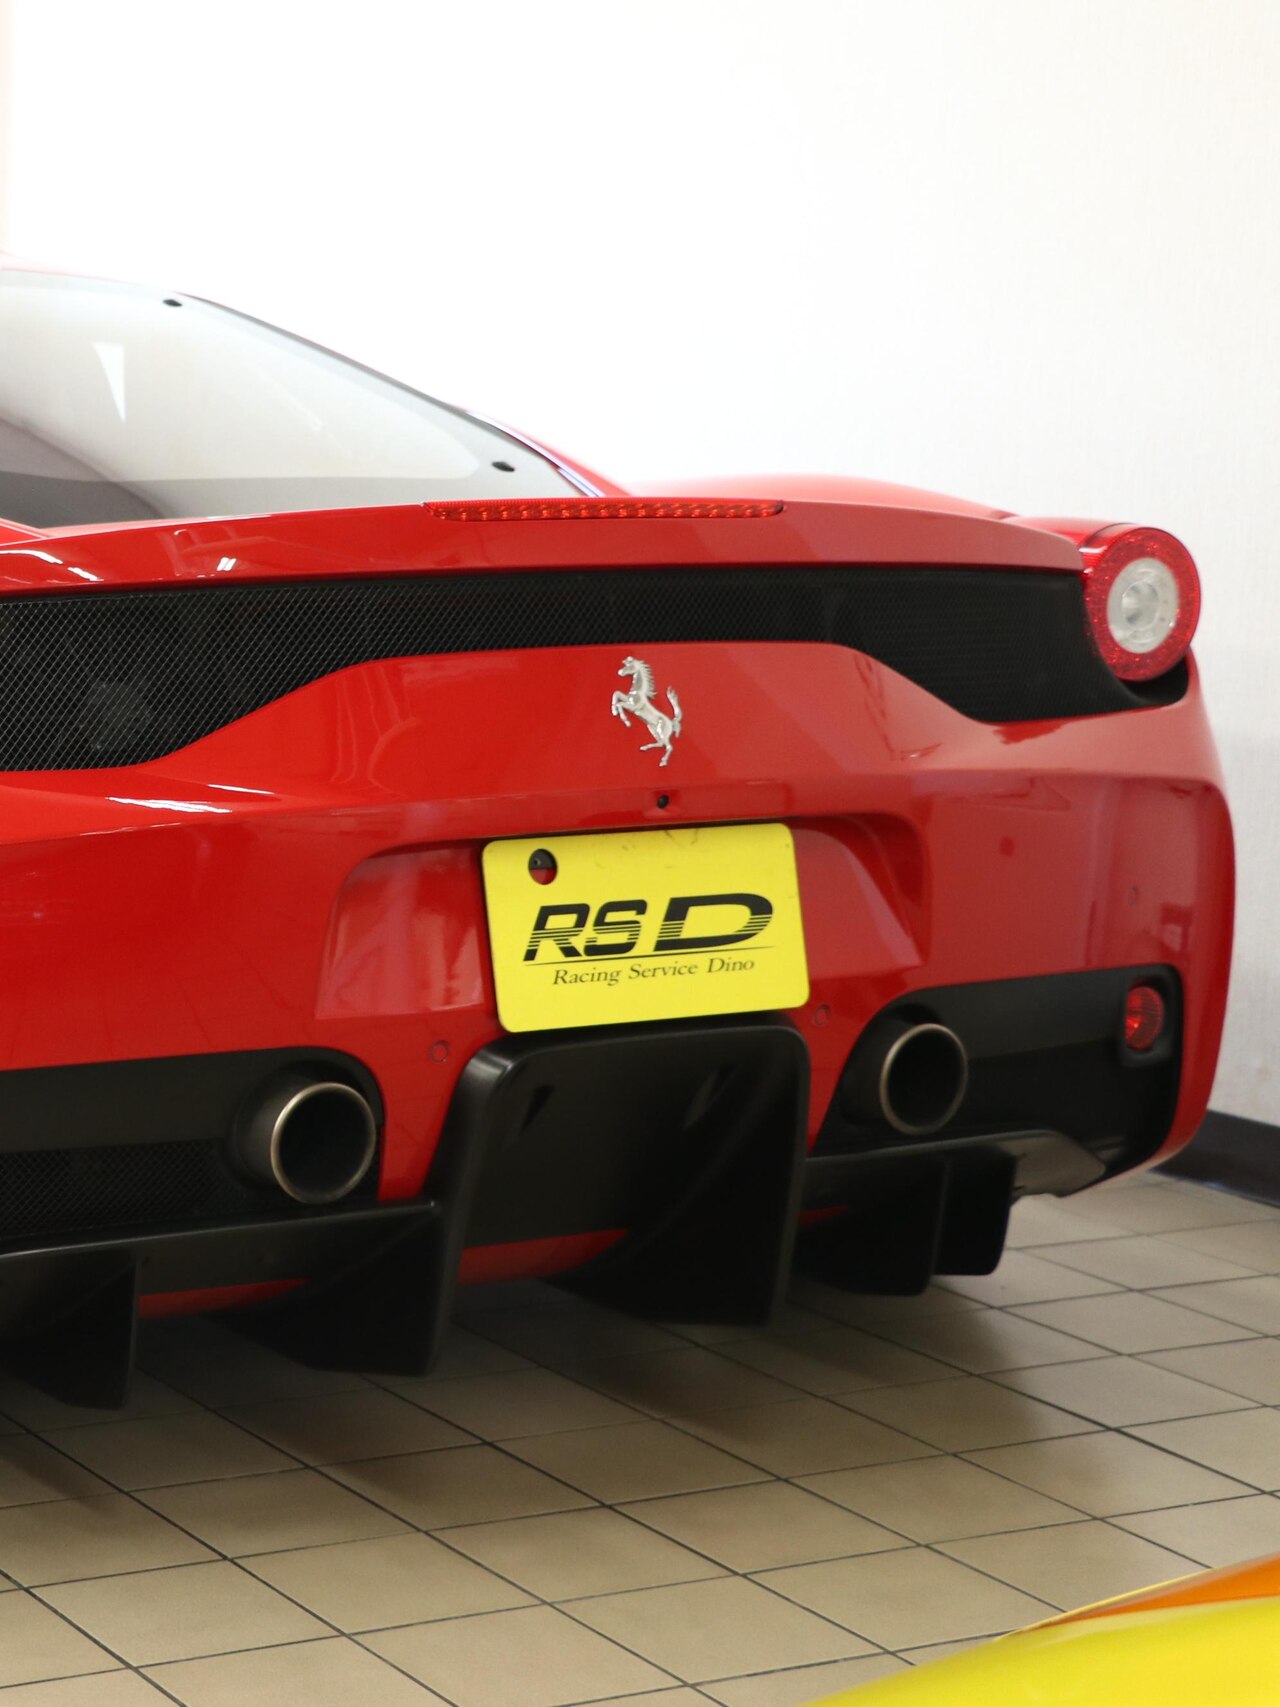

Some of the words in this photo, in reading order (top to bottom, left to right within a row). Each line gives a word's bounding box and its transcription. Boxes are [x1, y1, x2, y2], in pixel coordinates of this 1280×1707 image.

[552, 967, 621, 986] Racing
[628, 961, 698, 979] Service
[707, 957, 754, 973] Dino
